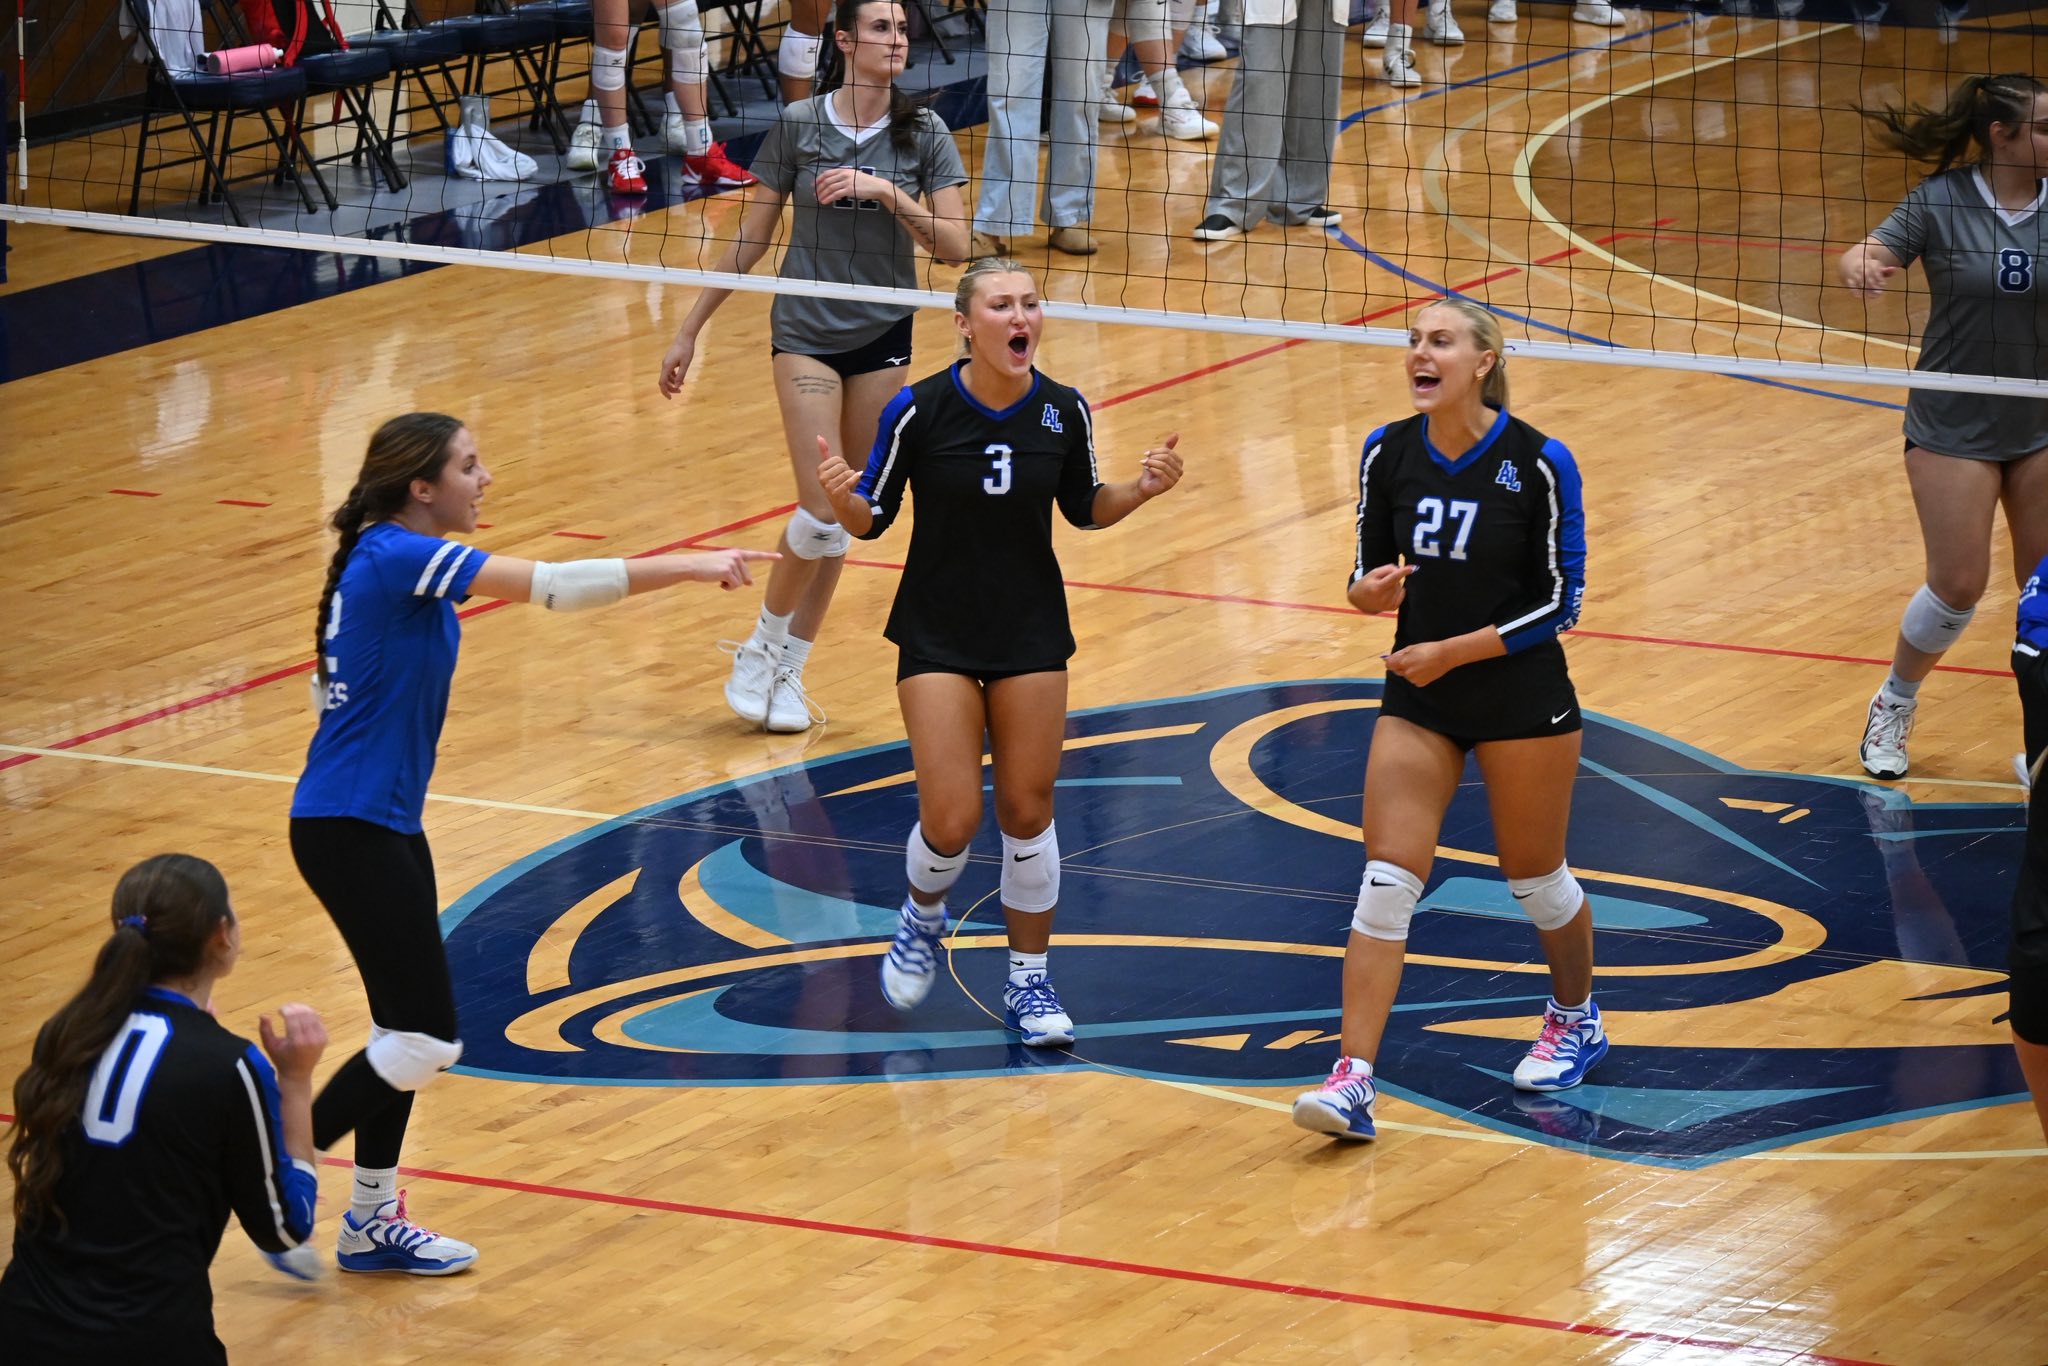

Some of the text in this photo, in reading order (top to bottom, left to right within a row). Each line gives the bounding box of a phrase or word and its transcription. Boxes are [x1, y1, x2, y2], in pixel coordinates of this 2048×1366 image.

[1998, 247, 2032, 293] 8
[1041, 403, 1063, 433] AL
[983, 443, 1012, 495] 3
[1495, 460, 1521, 492] AL
[1412, 496, 1479, 561] 27
[81, 1011, 171, 1146] 0
